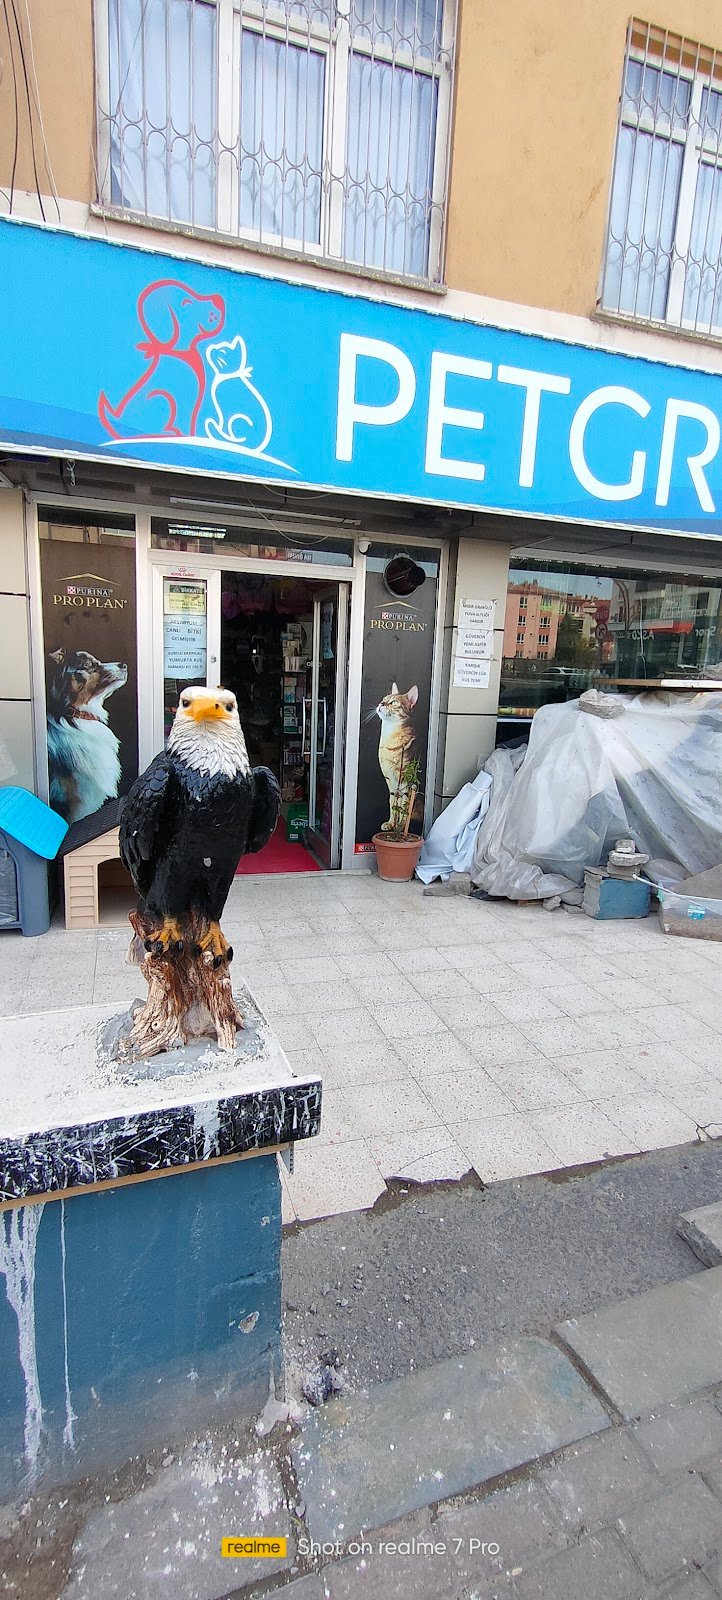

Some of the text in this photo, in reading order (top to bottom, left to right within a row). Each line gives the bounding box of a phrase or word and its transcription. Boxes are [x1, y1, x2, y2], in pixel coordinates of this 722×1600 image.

[335, 332, 721, 513] PETGR
[76, 587, 108, 596] PURINA
[53, 595, 124, 609] PRO PLAN
[388, 613, 413, 621] PURINA
[370, 620, 425, 631] PRO PLAN
